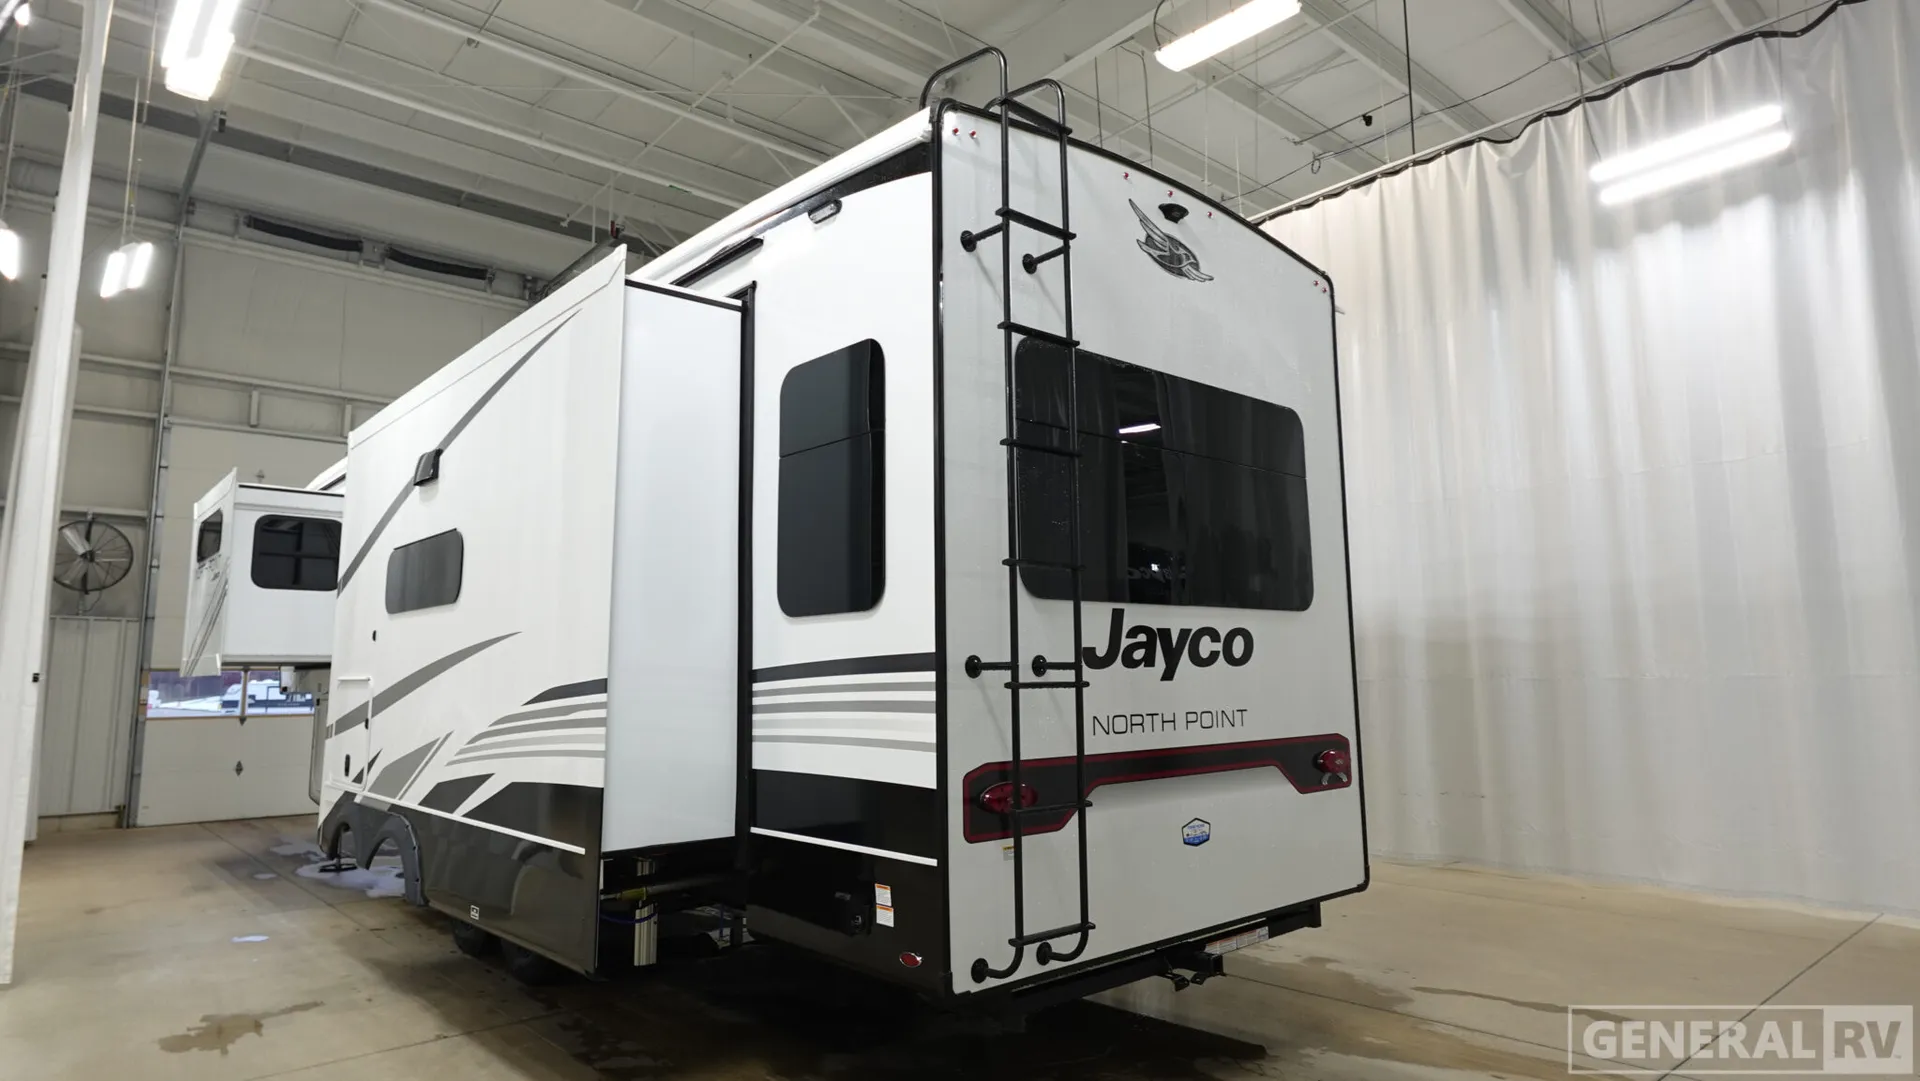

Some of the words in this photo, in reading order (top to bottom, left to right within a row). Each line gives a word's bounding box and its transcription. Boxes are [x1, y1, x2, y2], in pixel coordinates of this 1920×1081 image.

[1082, 608, 1254, 681] Jayco
[1092, 712, 1176, 736] NORTH
[1185, 709, 1248, 731] POINT
